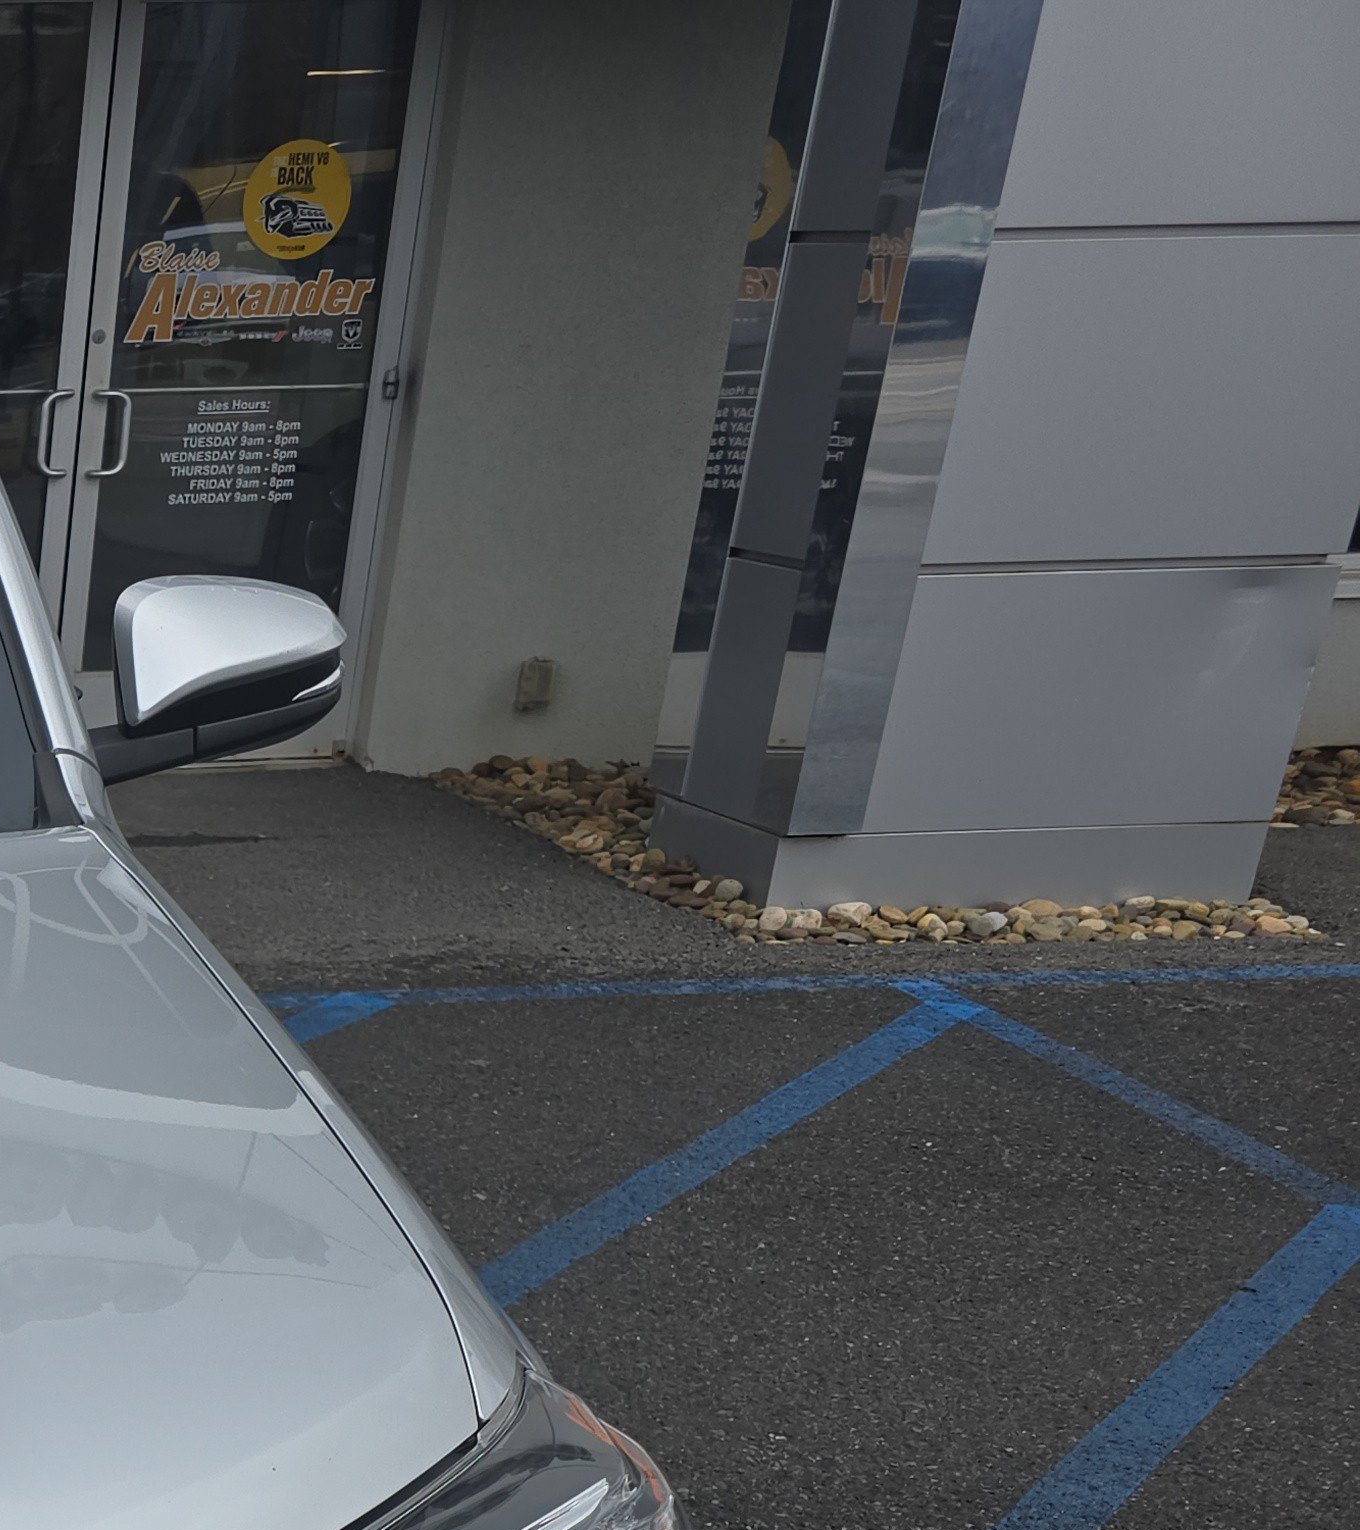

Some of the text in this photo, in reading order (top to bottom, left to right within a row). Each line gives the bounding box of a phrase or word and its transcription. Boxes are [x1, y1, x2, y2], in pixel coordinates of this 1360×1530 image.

[288, 152, 315, 166] HEMI
[317, 151, 330, 165] V8
[277, 166, 314, 185] BACK
[138, 240, 221, 274] Blaise
[124, 269, 376, 343] Alexander
[197, 399, 271, 412] Sales Hours:
[187, 421, 239, 433] MONDAY
[241, 421, 266, 432] 9am
[182, 436, 238, 448] TUESDAY
[240, 435, 264, 446] 9am
[160, 450, 236, 463] WEDNESDAY
[238, 450, 263, 460] 9am
[170, 464, 235, 476] THURSDAY
[237, 464, 261, 475] 9am
[189, 478, 233, 490] FRIDAY
[235, 478, 259, 489] 9am
[168, 493, 231, 505] SATURDAY
[234, 492, 258, 502] 9am
